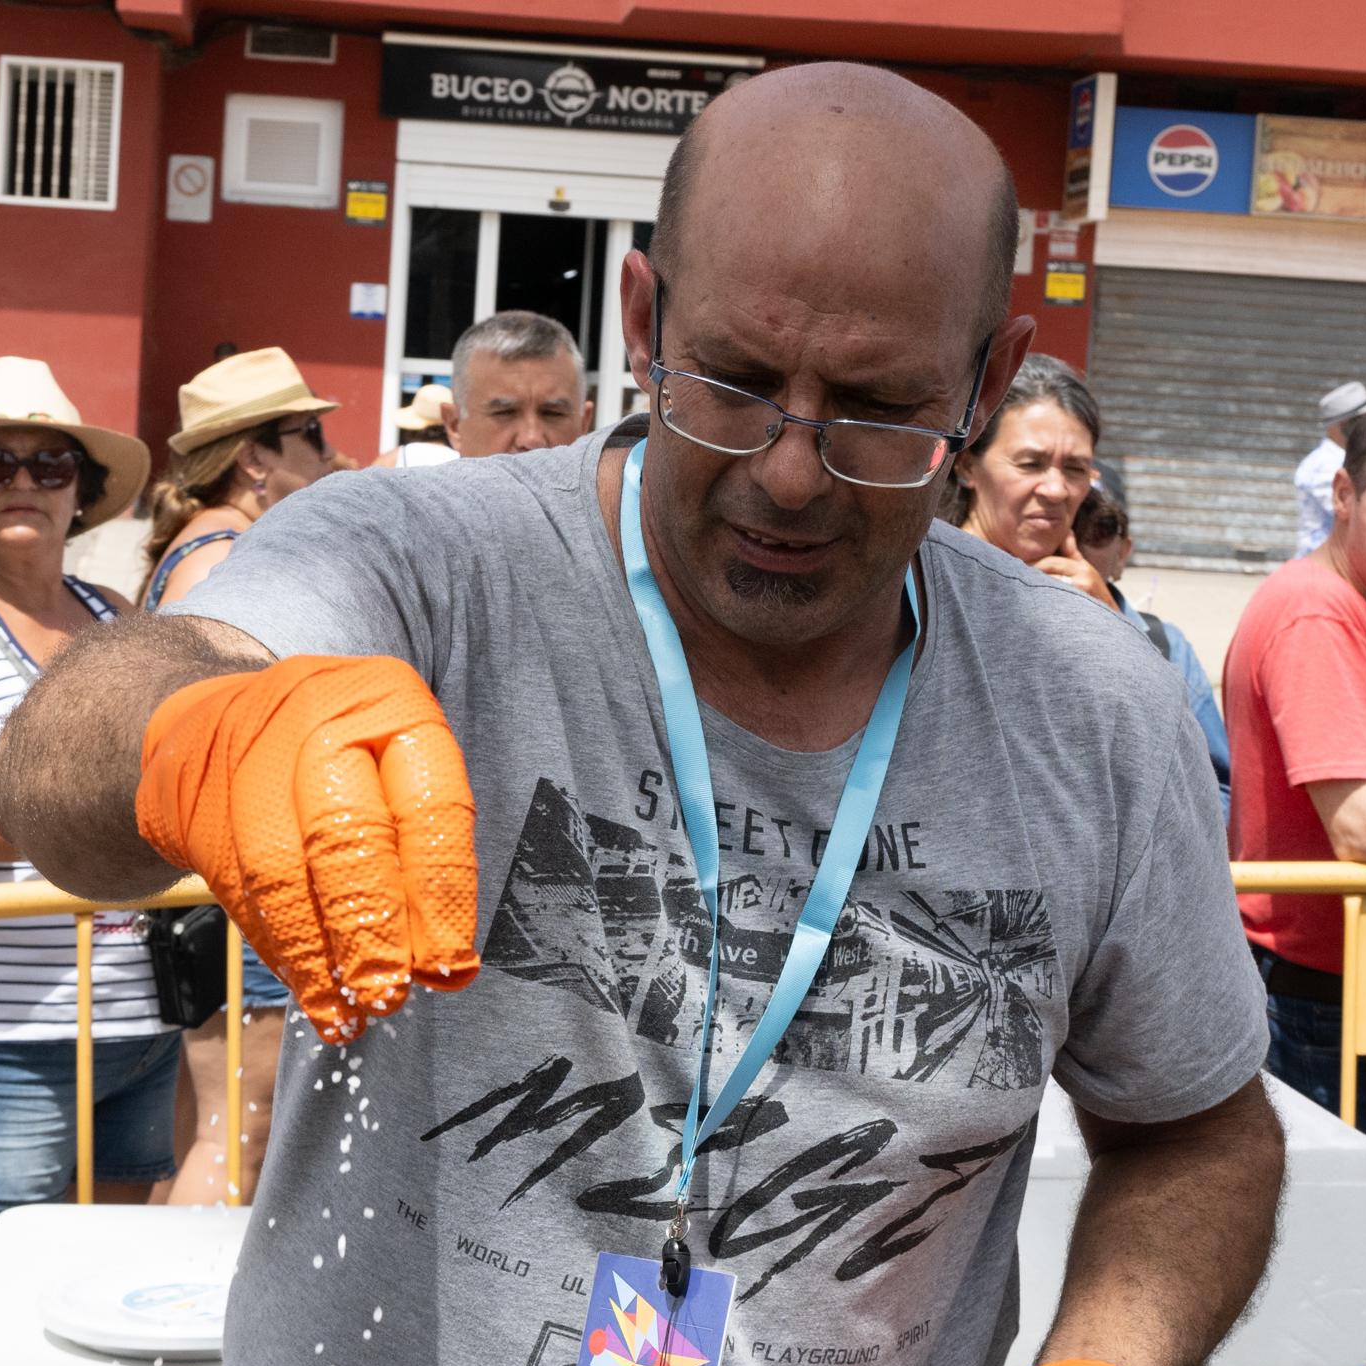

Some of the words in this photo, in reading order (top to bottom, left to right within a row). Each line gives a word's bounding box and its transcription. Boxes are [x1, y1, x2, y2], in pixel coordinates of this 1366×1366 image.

[431, 73, 533, 104] BUCEO
[606, 85, 709, 115] NORTE
[462, 105, 493, 119] DIVE
[497, 107, 552, 122] CENTER
[585, 113, 619, 126] GRAN
[620, 115, 675, 130] CANARIA
[1153, 151, 1213, 169] PEPSI
[635, 769, 792, 858] SEET
[397, 1198, 428, 1231] THE
[456, 1235, 531, 1278] WORLD
[752, 1341, 880, 1365] PLAYGROUND
[895, 1320, 931, 1351] SPIRIT
